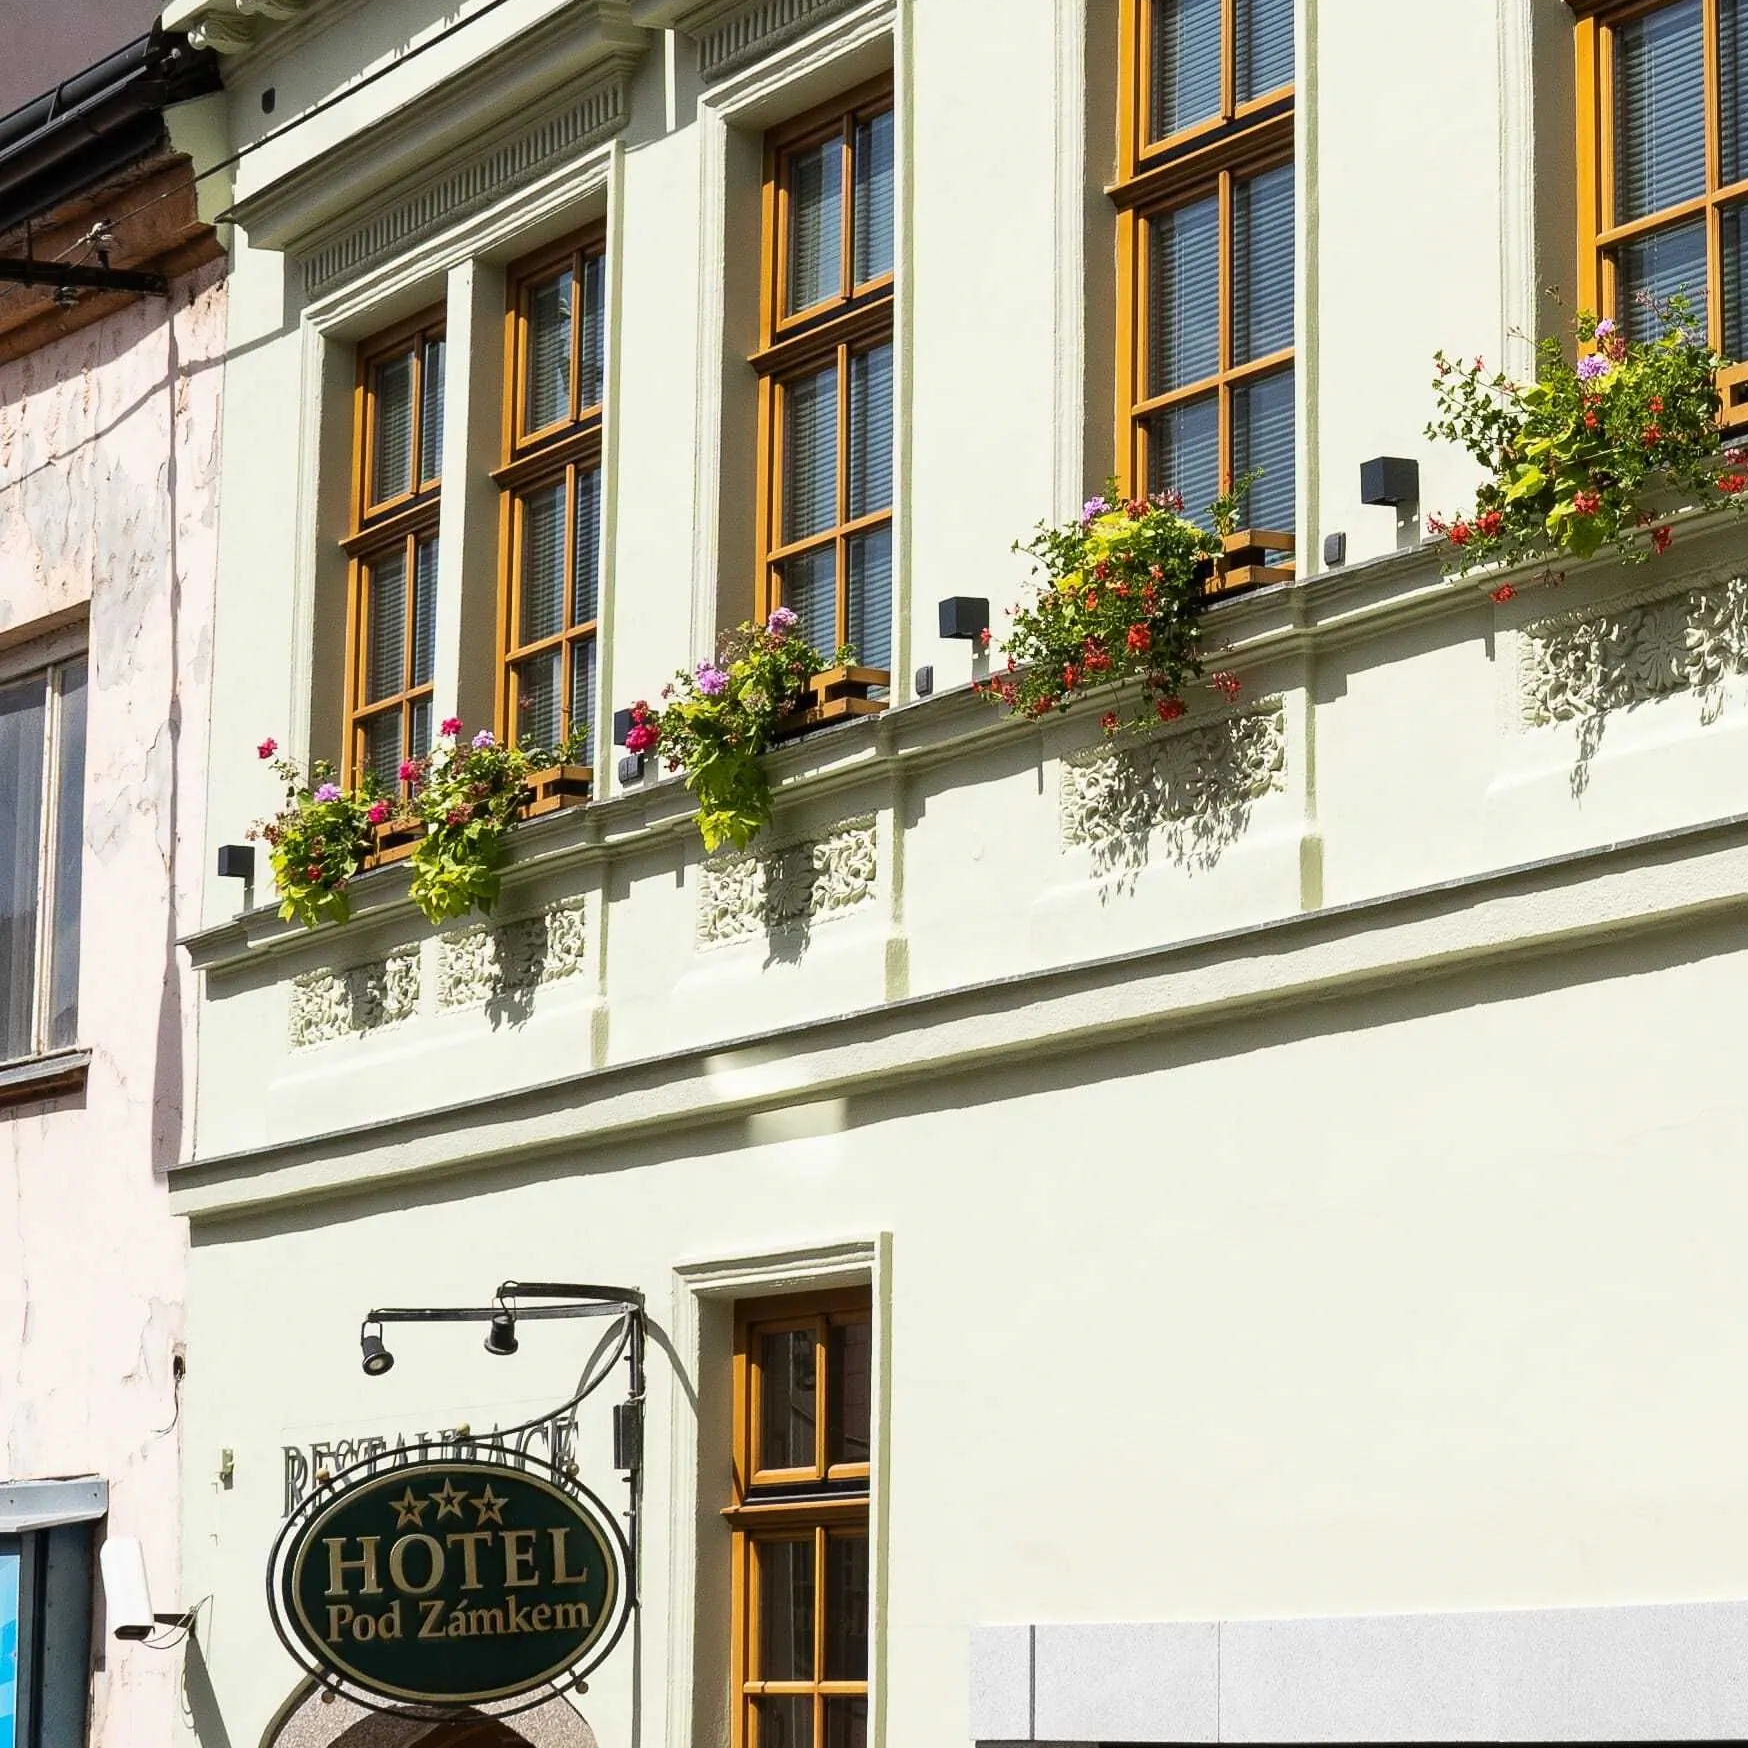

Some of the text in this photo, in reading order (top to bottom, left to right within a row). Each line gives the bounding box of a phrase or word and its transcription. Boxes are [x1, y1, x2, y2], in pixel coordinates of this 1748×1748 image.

[322, 1527, 588, 1596] HOTEL
[325, 1595, 592, 1643] Pod Zámkem
